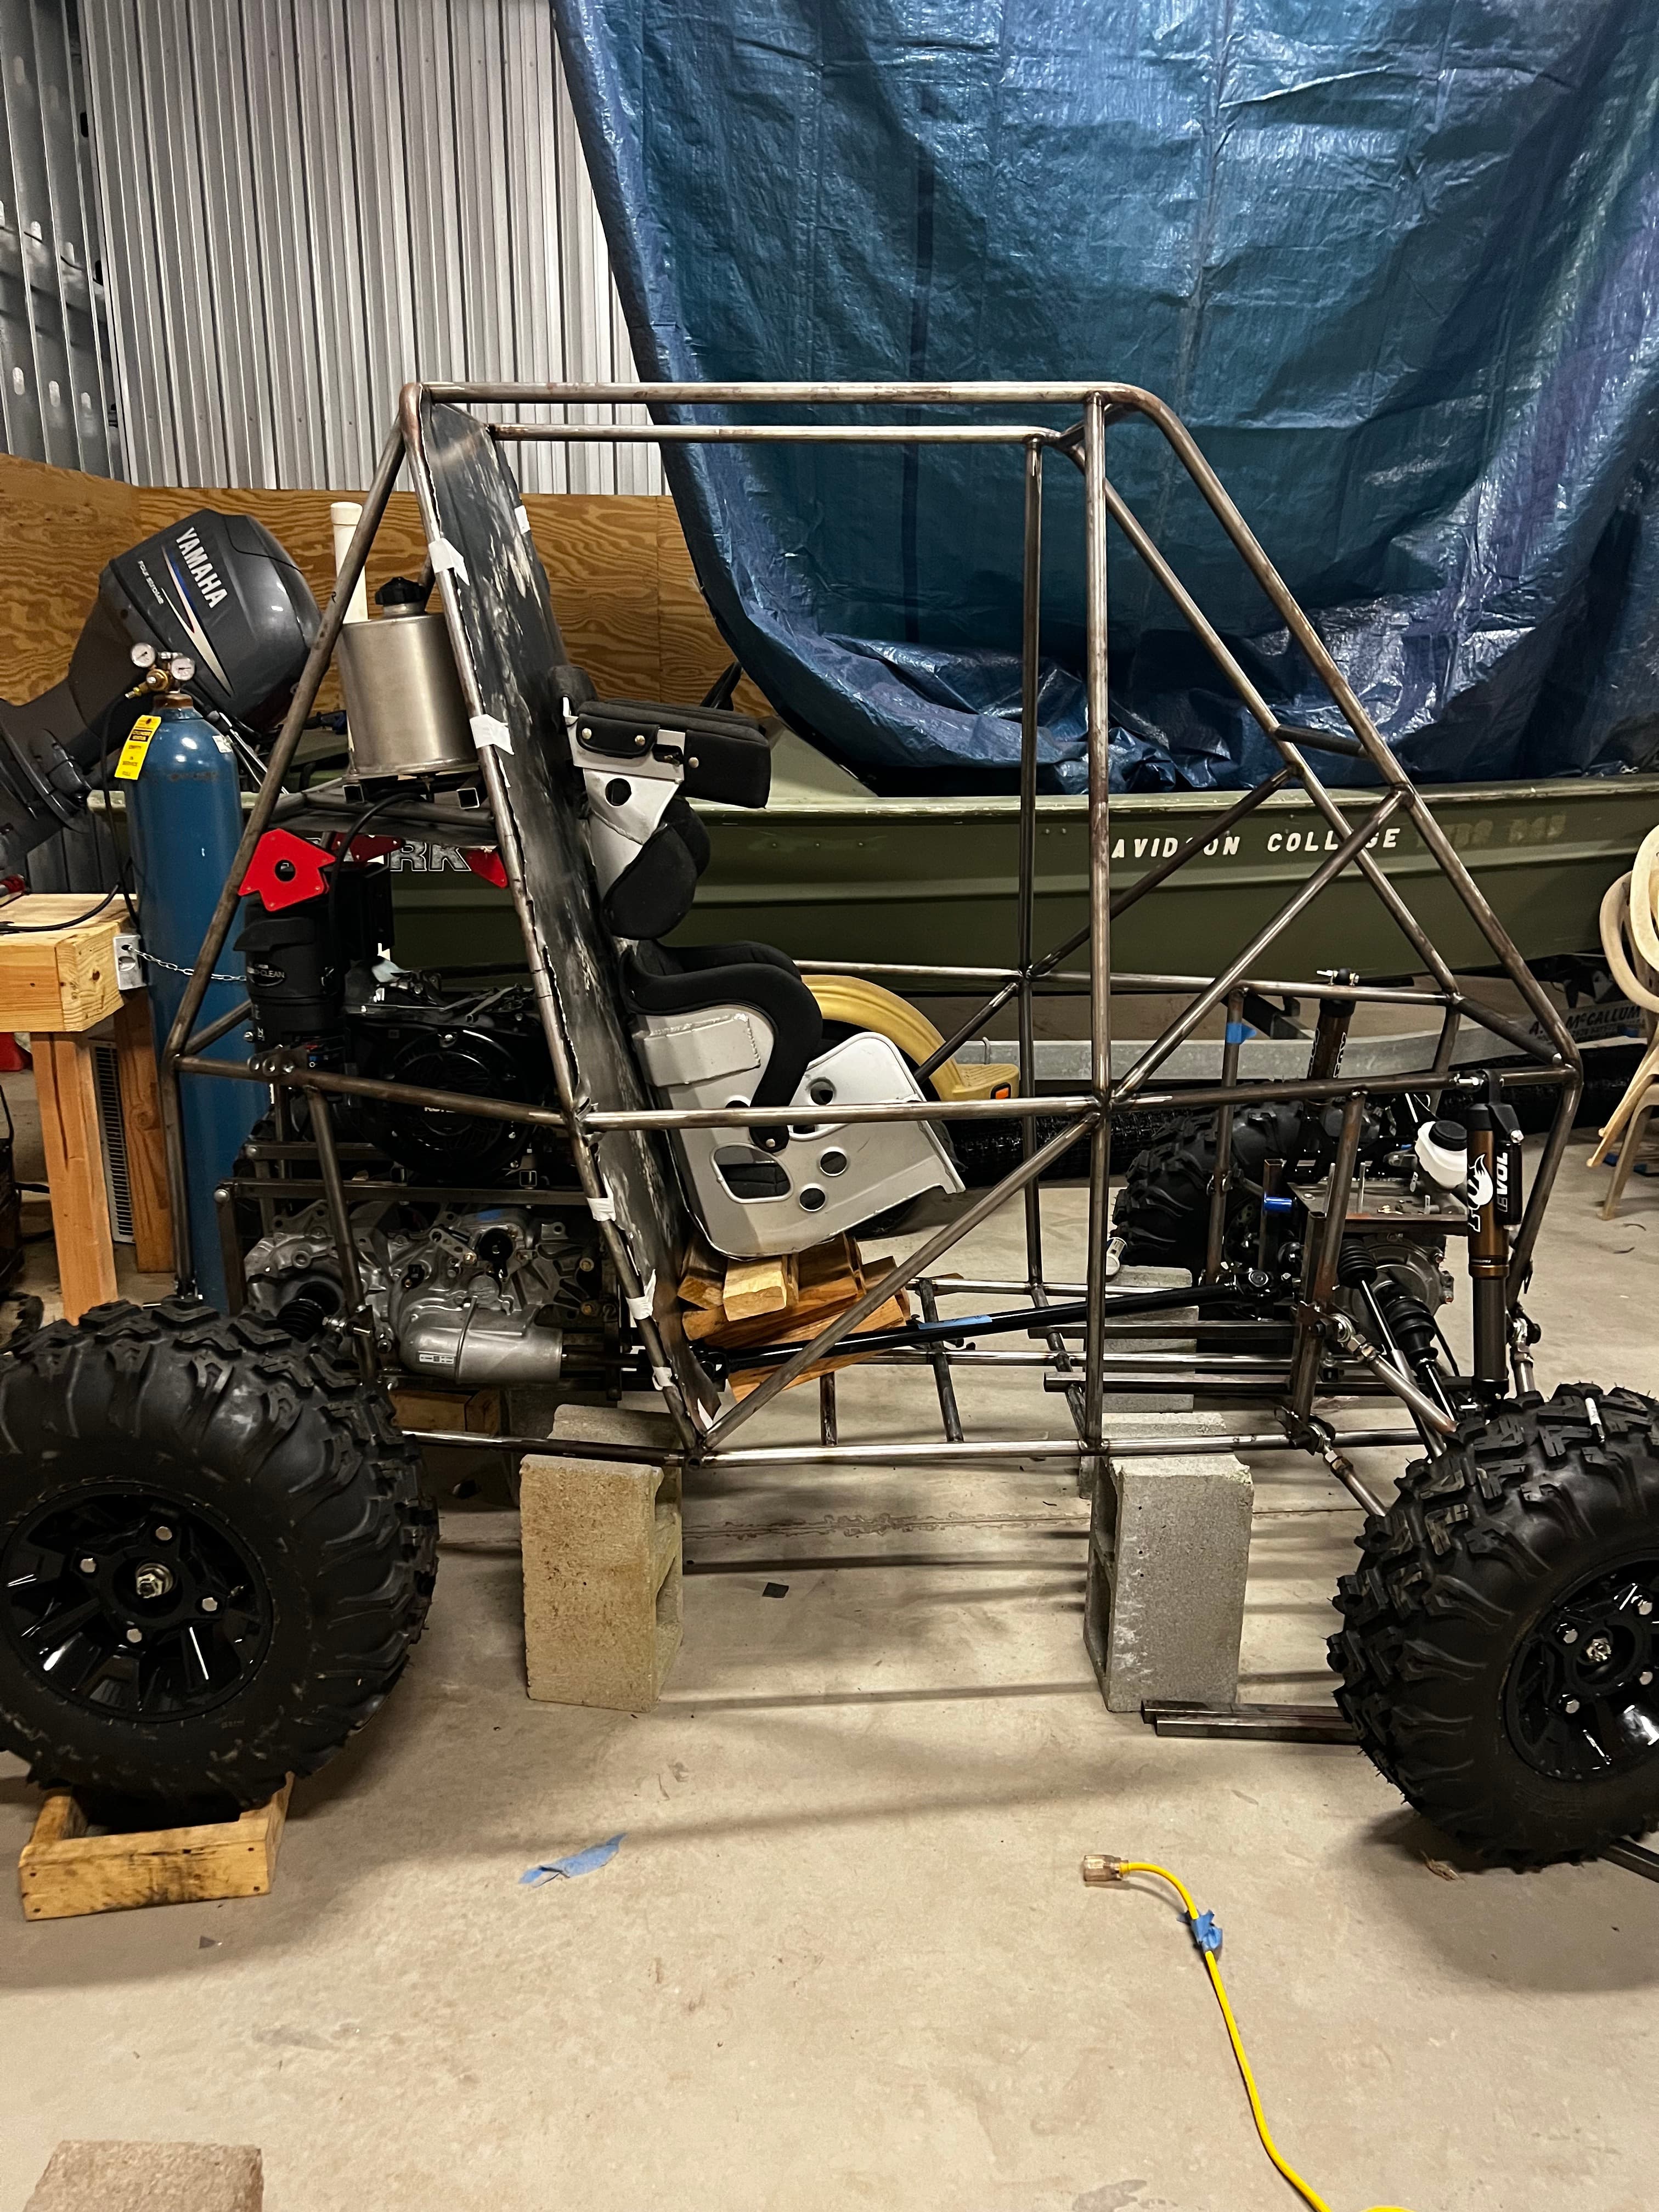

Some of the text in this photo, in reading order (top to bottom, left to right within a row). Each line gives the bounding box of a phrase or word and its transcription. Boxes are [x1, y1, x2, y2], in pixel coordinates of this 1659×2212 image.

[176, 527, 228, 609] YAMAHA
[388, 840, 472, 872] RK
[1111, 836, 1240, 859] AVIDON
[1267, 828, 1401, 852] COLLE
